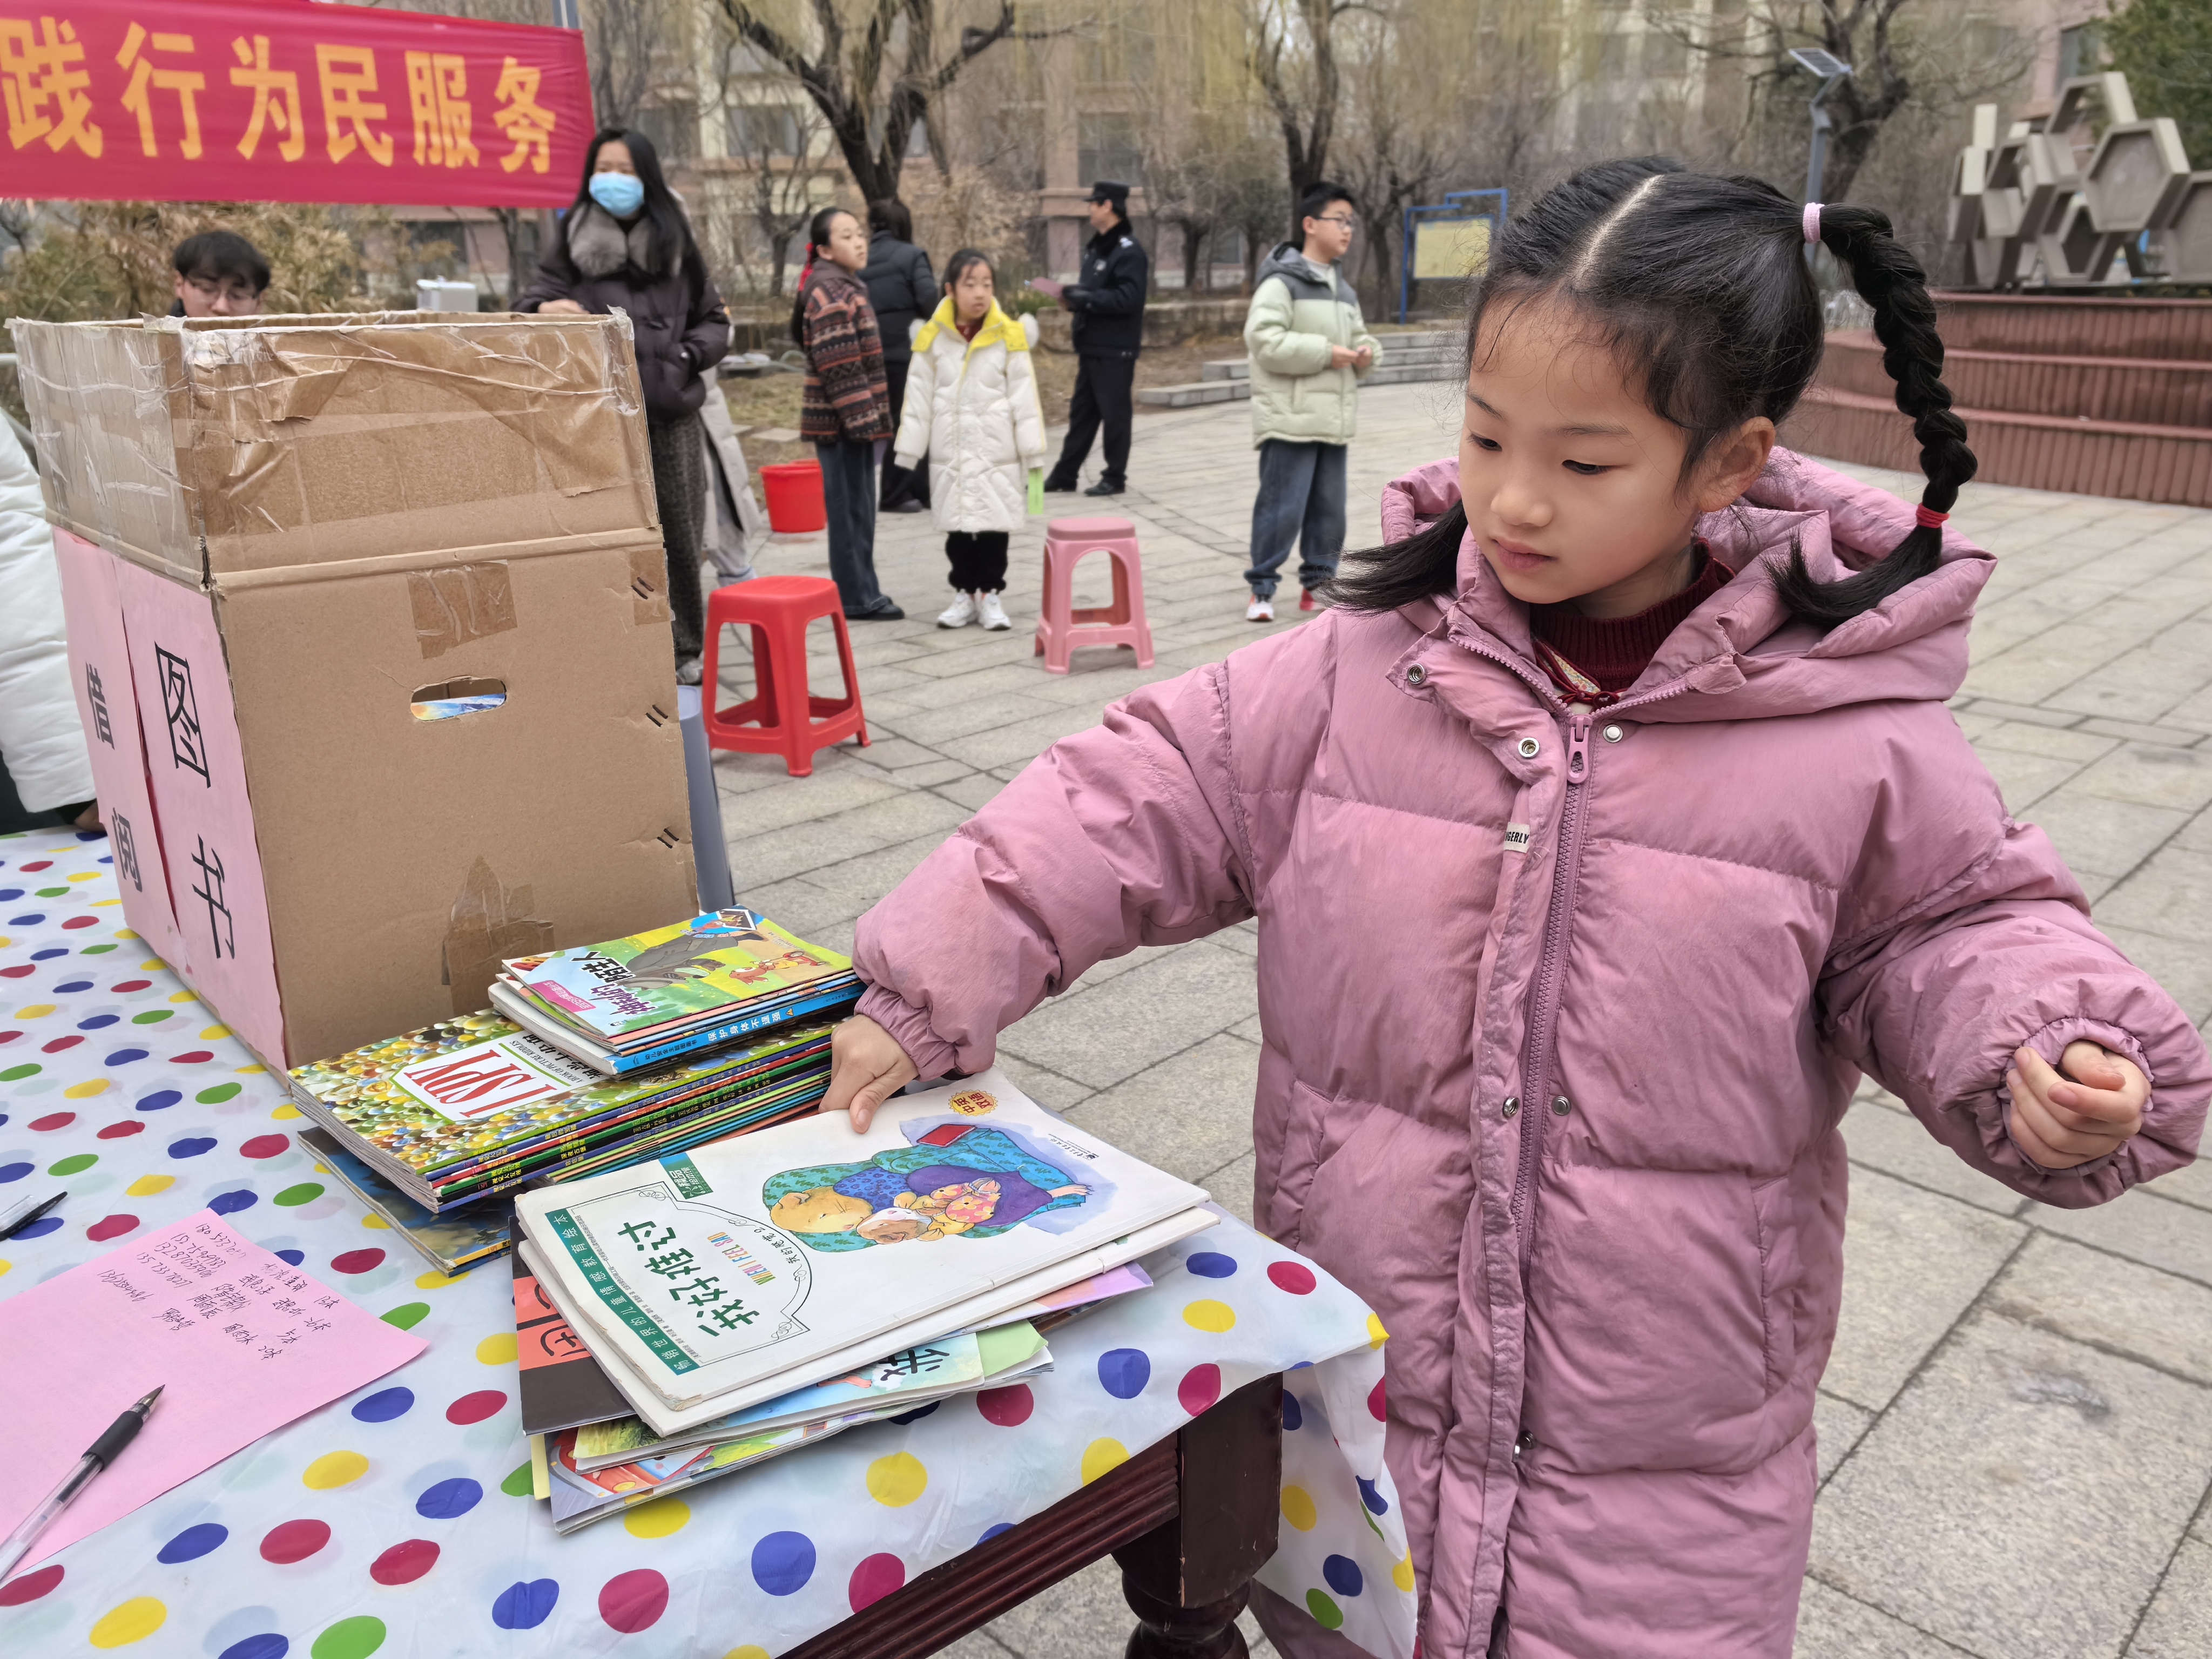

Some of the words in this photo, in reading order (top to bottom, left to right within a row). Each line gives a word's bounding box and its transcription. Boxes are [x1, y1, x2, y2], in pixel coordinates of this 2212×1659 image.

[0, 16, 556, 173] 践行为民服务
[154, 641, 235, 959] 图书
[706, 1010, 782, 1042] 保护身体不逞强
[509, 1039, 535, 1055] RIDDLES
[530, 1054, 556, 1069] PICTURE
[403, 1049, 537, 1104] SPY
[559, 1071, 580, 1081] BOOK
[459, 1083, 557, 1118] I
[706, 1230, 733, 1248] SAD
[721, 1244, 752, 1264] FEEL
[617, 1220, 760, 1337] 我好难过
[743, 1263, 775, 1285] WHEN
[553, 1215, 692, 1370] 畅销世界的儿童情感教育绘本
